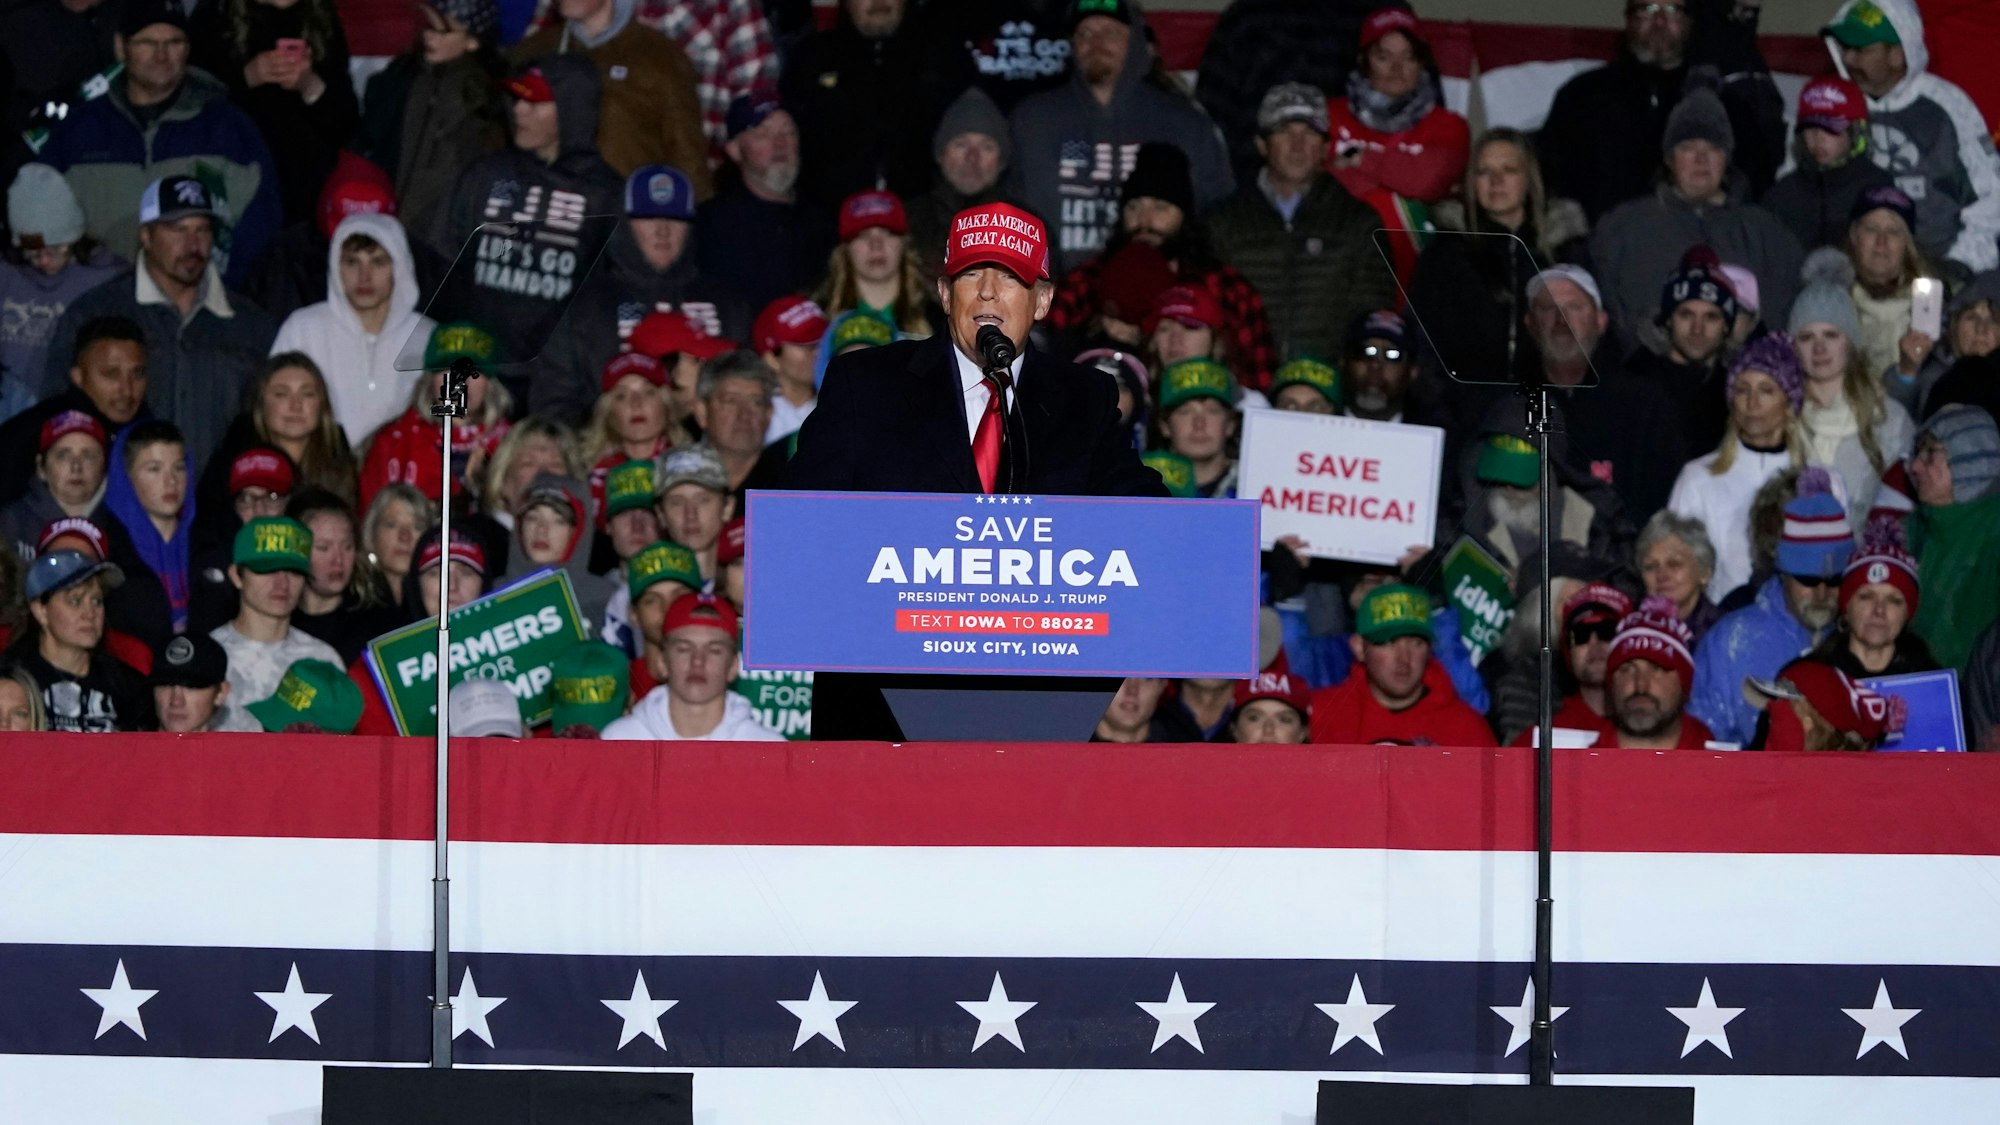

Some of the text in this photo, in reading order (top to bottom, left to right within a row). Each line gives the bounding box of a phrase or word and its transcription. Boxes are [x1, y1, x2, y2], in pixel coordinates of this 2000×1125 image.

[1034, 38, 1072, 57] GO
[956, 213, 990, 232] MAKE
[989, 213, 1041, 243] AMERICA
[960, 231, 1034, 258] GREAT AGAIN
[540, 248, 577, 276] GO
[1297, 451, 1382, 483] SAVE
[1261, 485, 1416, 524] AMERICA!
[954, 516, 1053, 543] SAVE
[866, 546, 1140, 587] AMERICA
[898, 591, 1108, 605] PRESIDENT DONALD J. TRUMP
[910, 614, 1094, 630] TEXT IOWA TO 88022
[397, 605, 564, 687] FARMERS
[923, 640, 1080, 656] SIOUX CITY, IOWA
[463, 655, 517, 681] FOR
[759, 684, 812, 707] FOR
